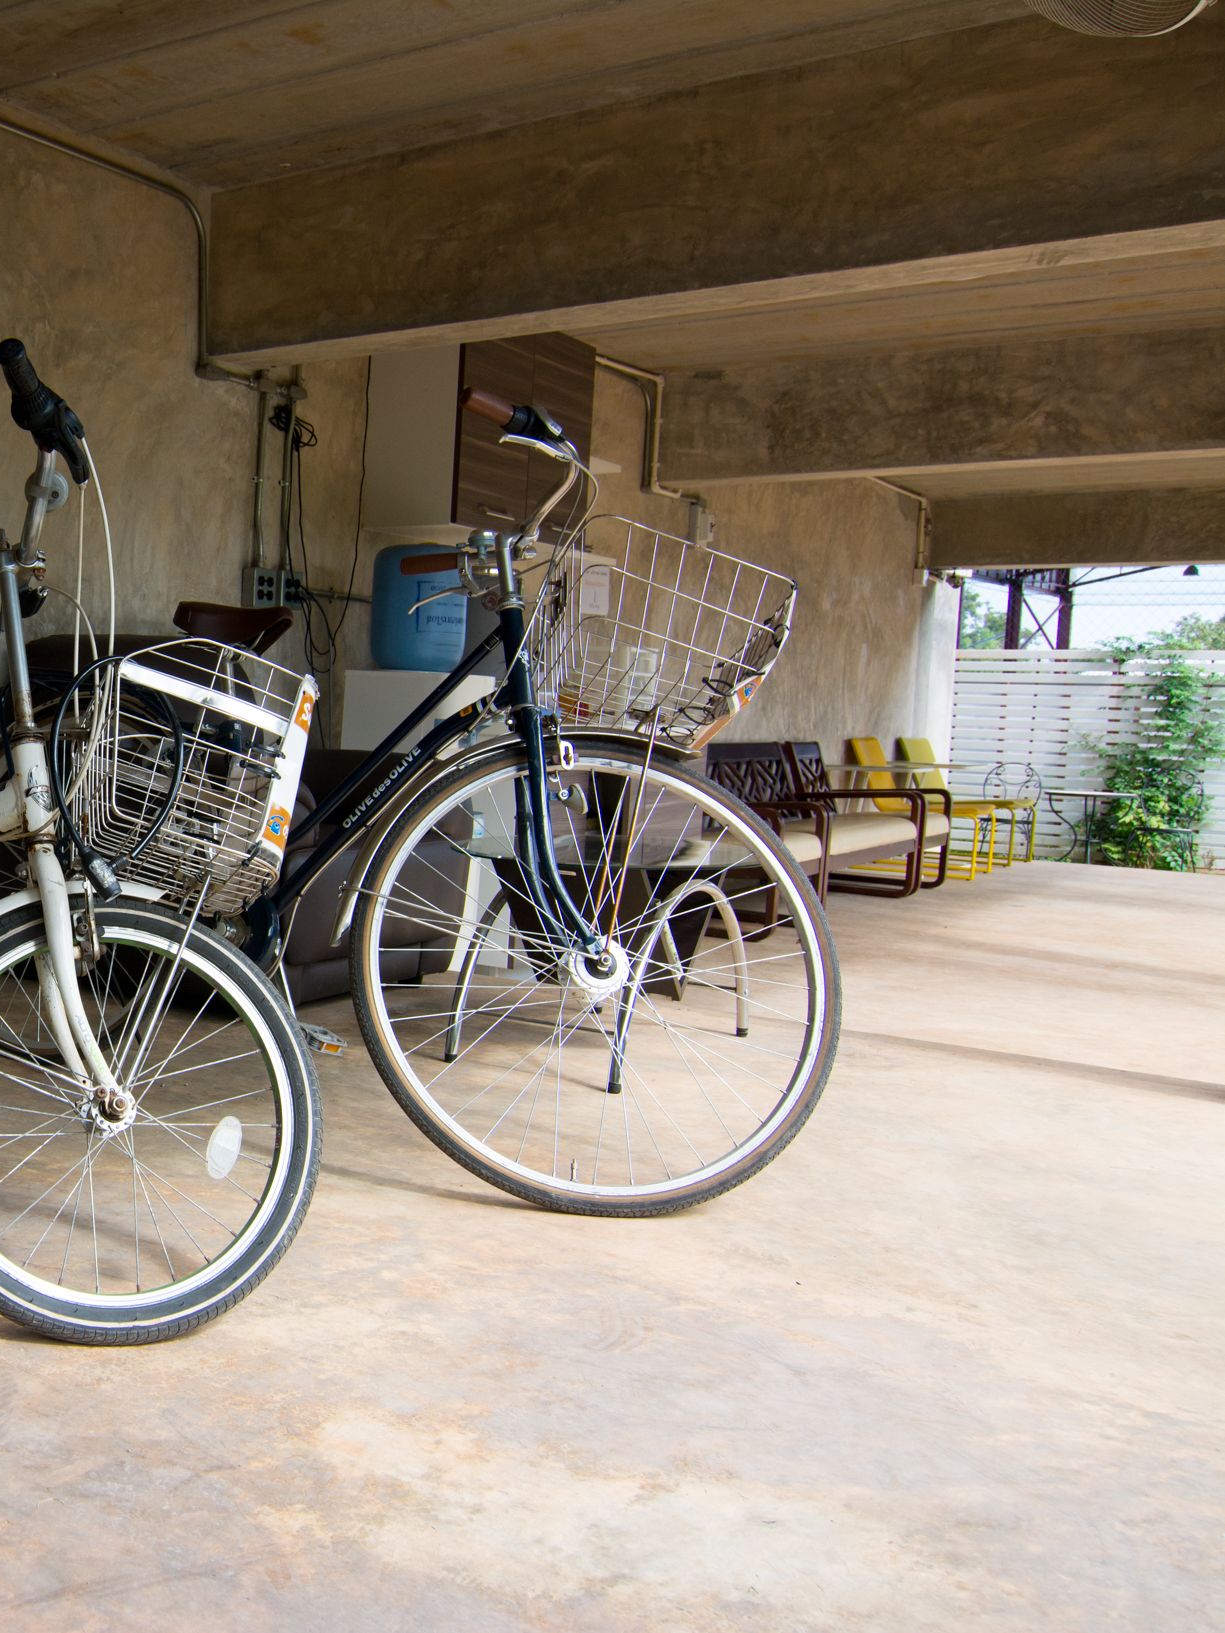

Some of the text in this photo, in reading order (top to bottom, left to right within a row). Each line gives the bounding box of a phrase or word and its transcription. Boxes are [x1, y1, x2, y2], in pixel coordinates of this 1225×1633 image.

[342, 746, 422, 829] OLIVE des OLIVE
